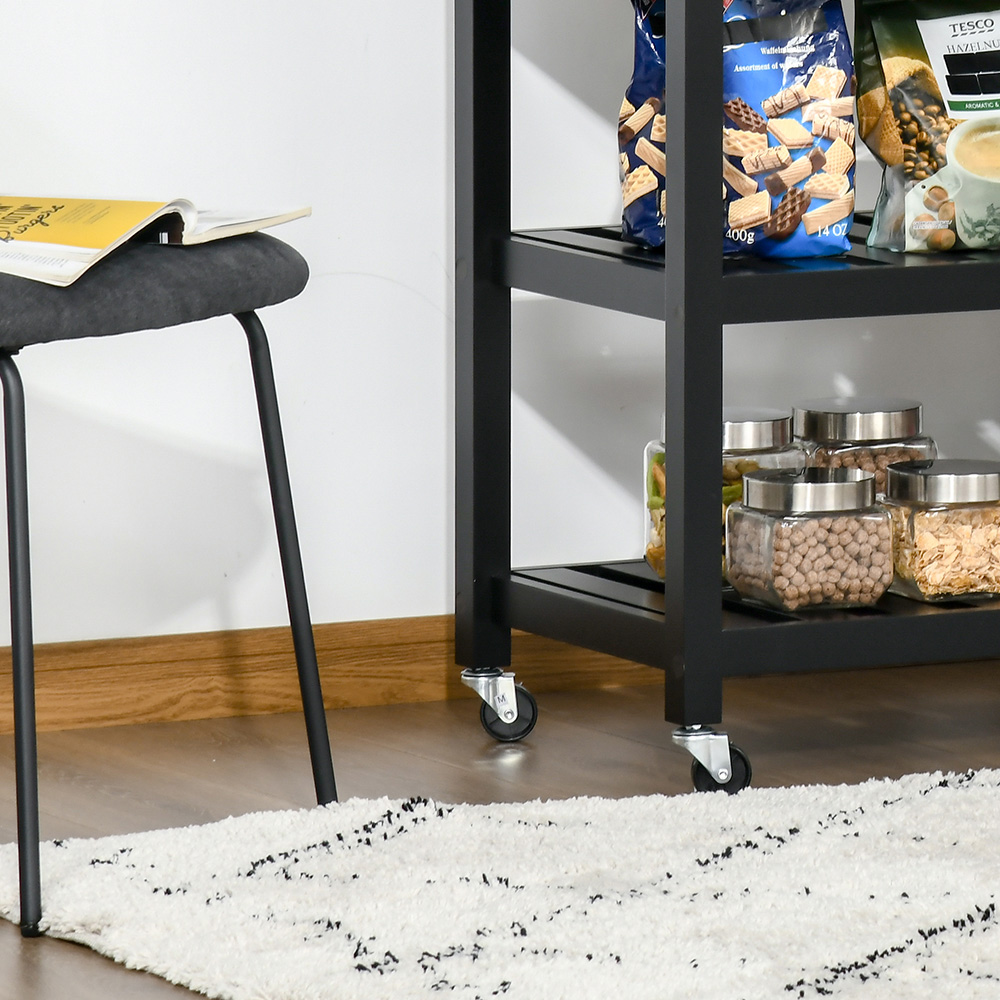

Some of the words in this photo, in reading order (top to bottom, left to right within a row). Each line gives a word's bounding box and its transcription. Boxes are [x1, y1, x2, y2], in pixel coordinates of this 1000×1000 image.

[949, 18, 994, 32] TESCO
[733, 63, 770, 73] Assortment
[771, 61, 779, 70] of
[725, 228, 755, 244] 400g
[817, 226, 830, 237] 14
